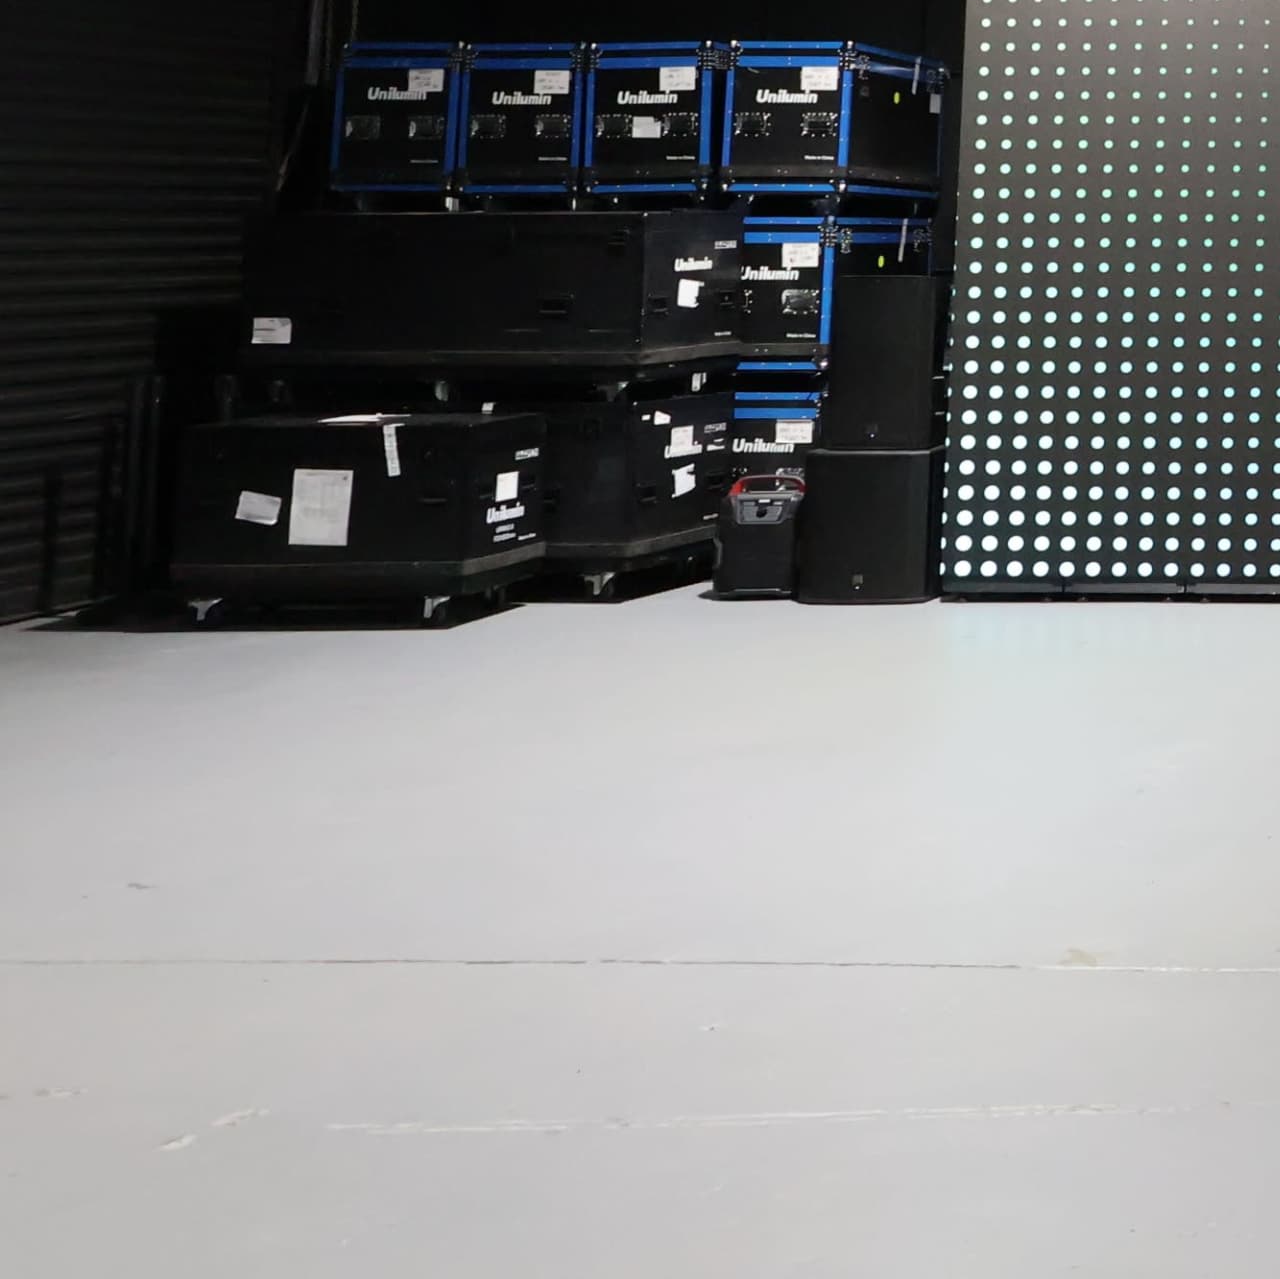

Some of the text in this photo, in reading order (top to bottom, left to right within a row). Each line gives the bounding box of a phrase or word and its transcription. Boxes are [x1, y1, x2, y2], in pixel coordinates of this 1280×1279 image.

[367, 86, 427, 101] Unilumin
[491, 91, 552, 106] Unilumin
[616, 89, 678, 105] Unilumin
[755, 88, 819, 104] Unilumin
